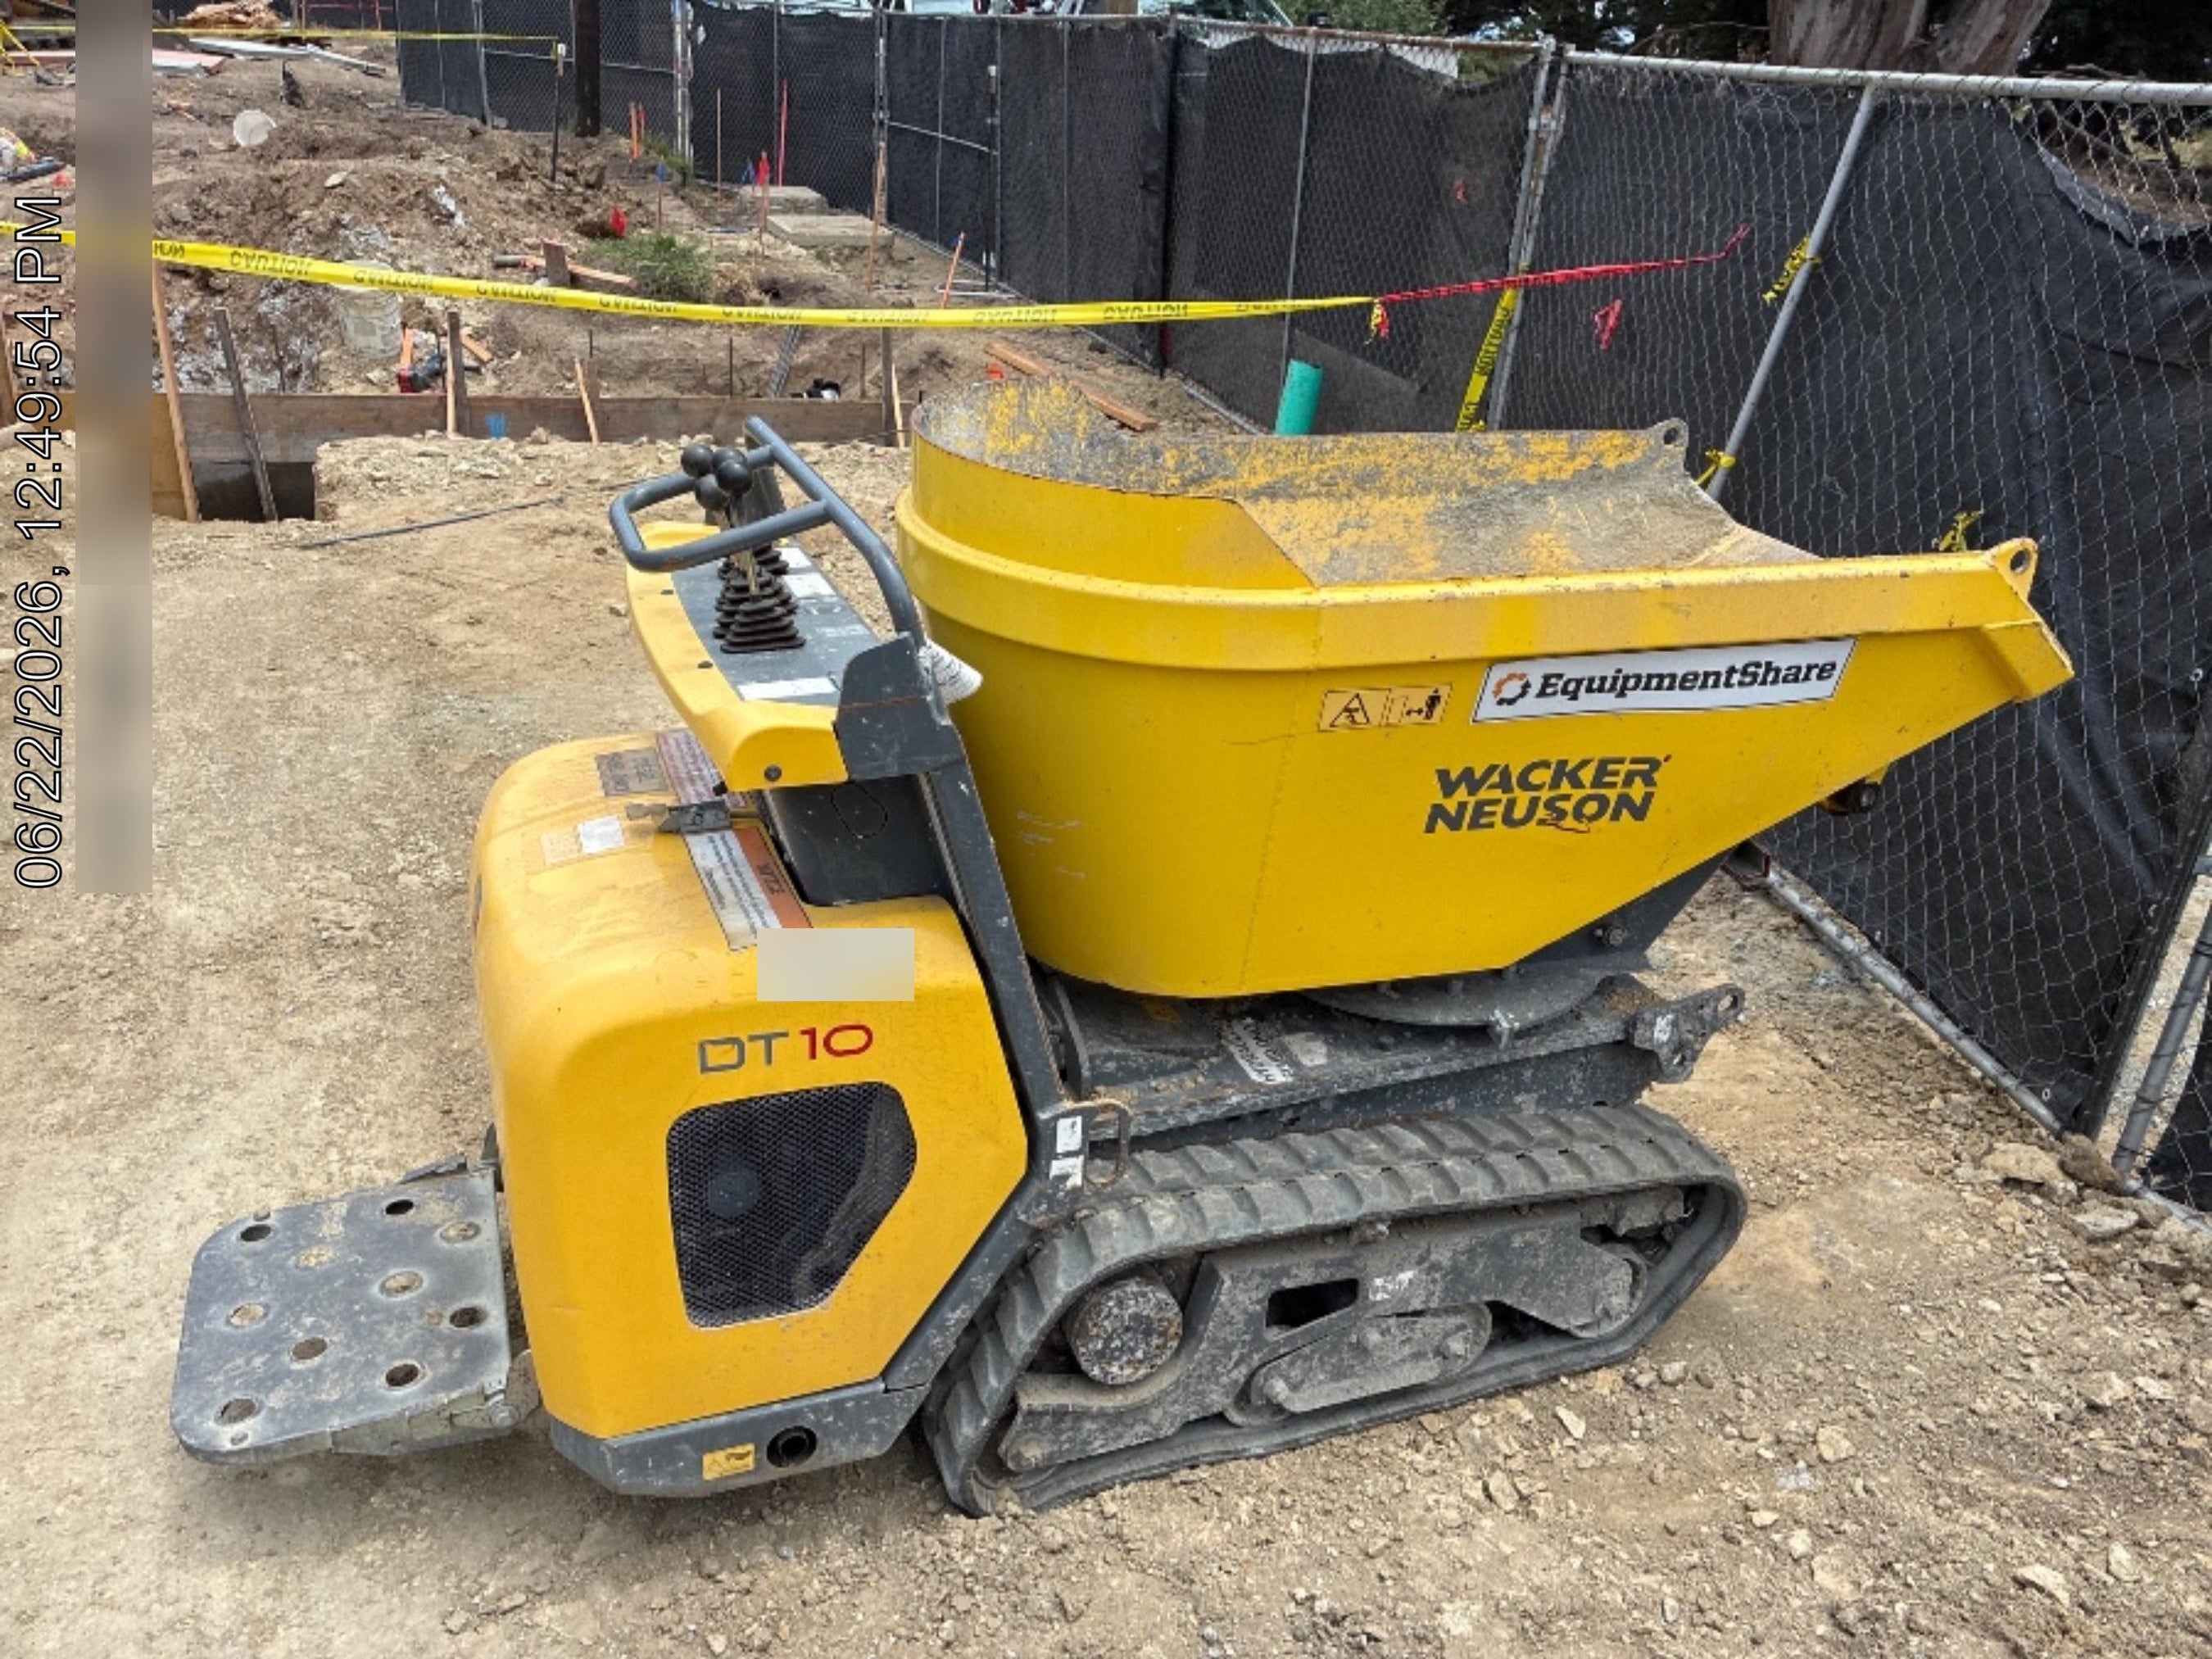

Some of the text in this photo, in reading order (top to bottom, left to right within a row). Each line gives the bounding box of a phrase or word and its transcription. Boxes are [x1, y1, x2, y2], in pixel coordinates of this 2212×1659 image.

[1534, 660, 1837, 700] EquipmentShare
[1435, 755, 1664, 800] WACKER
[1423, 791, 1656, 834] NEUSON
